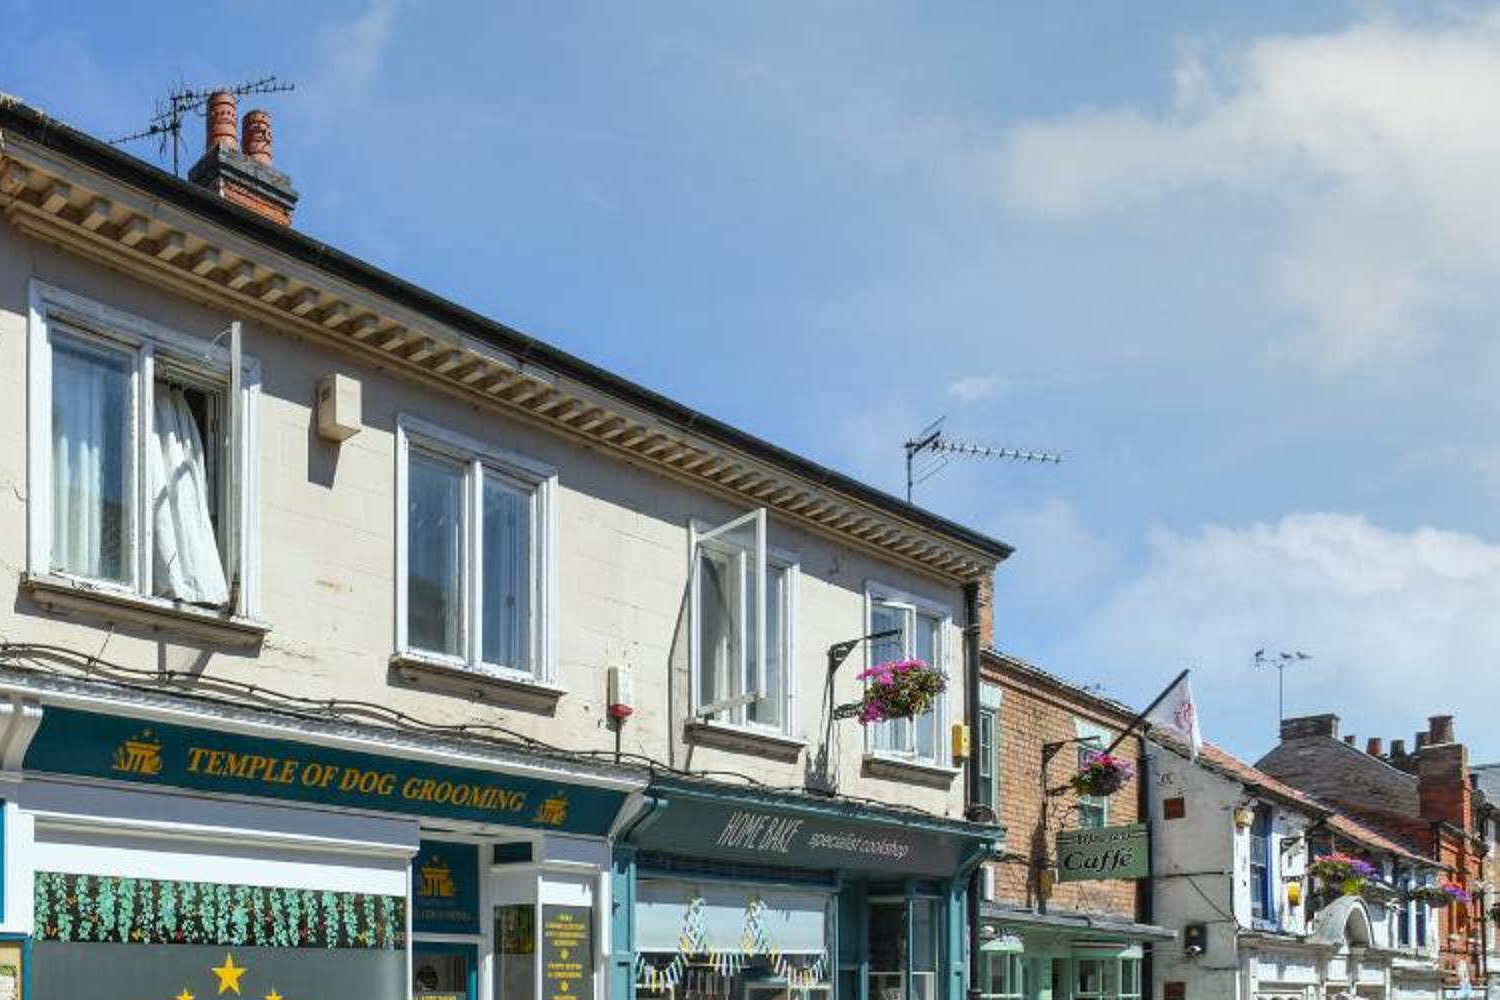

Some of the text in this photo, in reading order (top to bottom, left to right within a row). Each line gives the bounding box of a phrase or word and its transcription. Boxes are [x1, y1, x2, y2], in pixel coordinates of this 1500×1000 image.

[187, 747, 527, 813] TEMPLE OF DOG GROOMING
[716, 810, 805, 854] HOME BAKE
